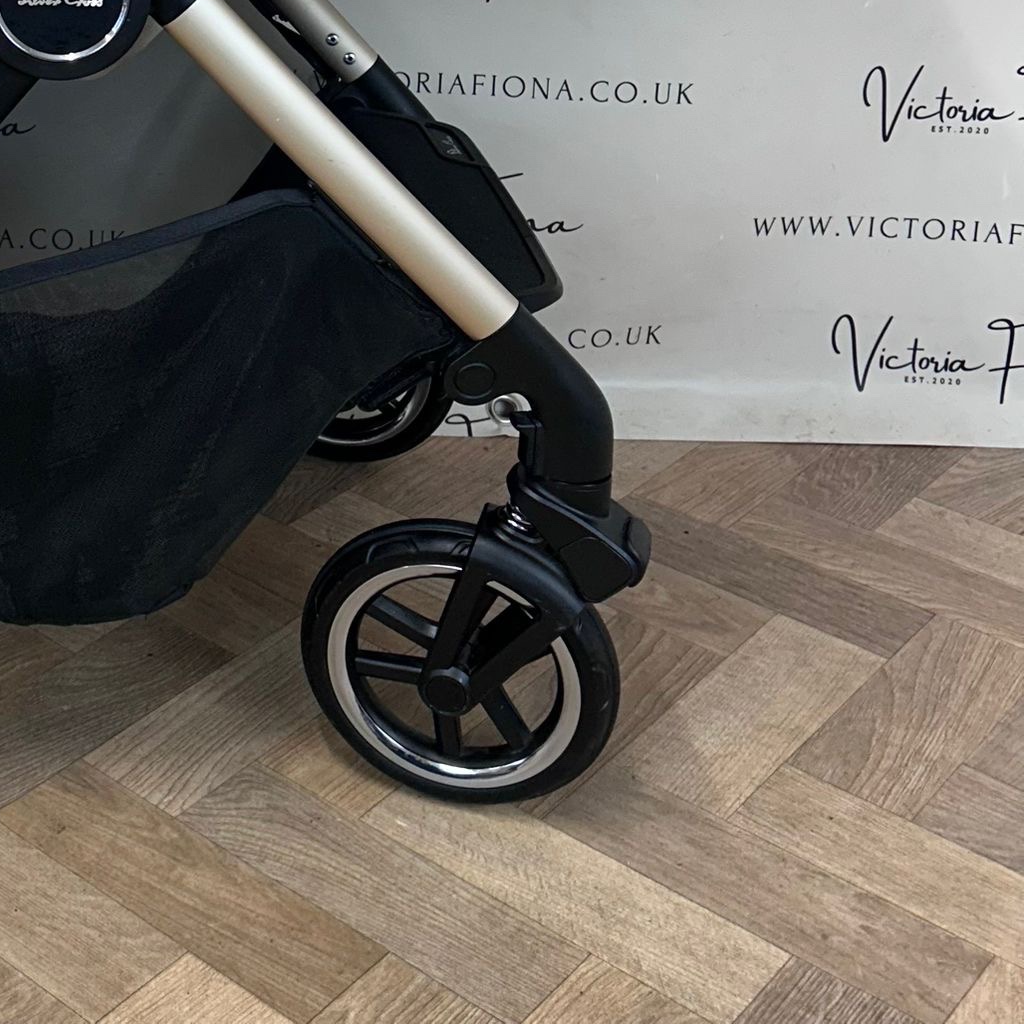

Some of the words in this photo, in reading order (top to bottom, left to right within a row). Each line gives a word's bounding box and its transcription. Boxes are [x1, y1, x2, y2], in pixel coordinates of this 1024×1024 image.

[863, 65, 1015, 142] Victoria
[931, 126, 989, 135] EST.2020
[831, 314, 985, 392] Victoria
[904, 376, 962, 386] EST.2020
